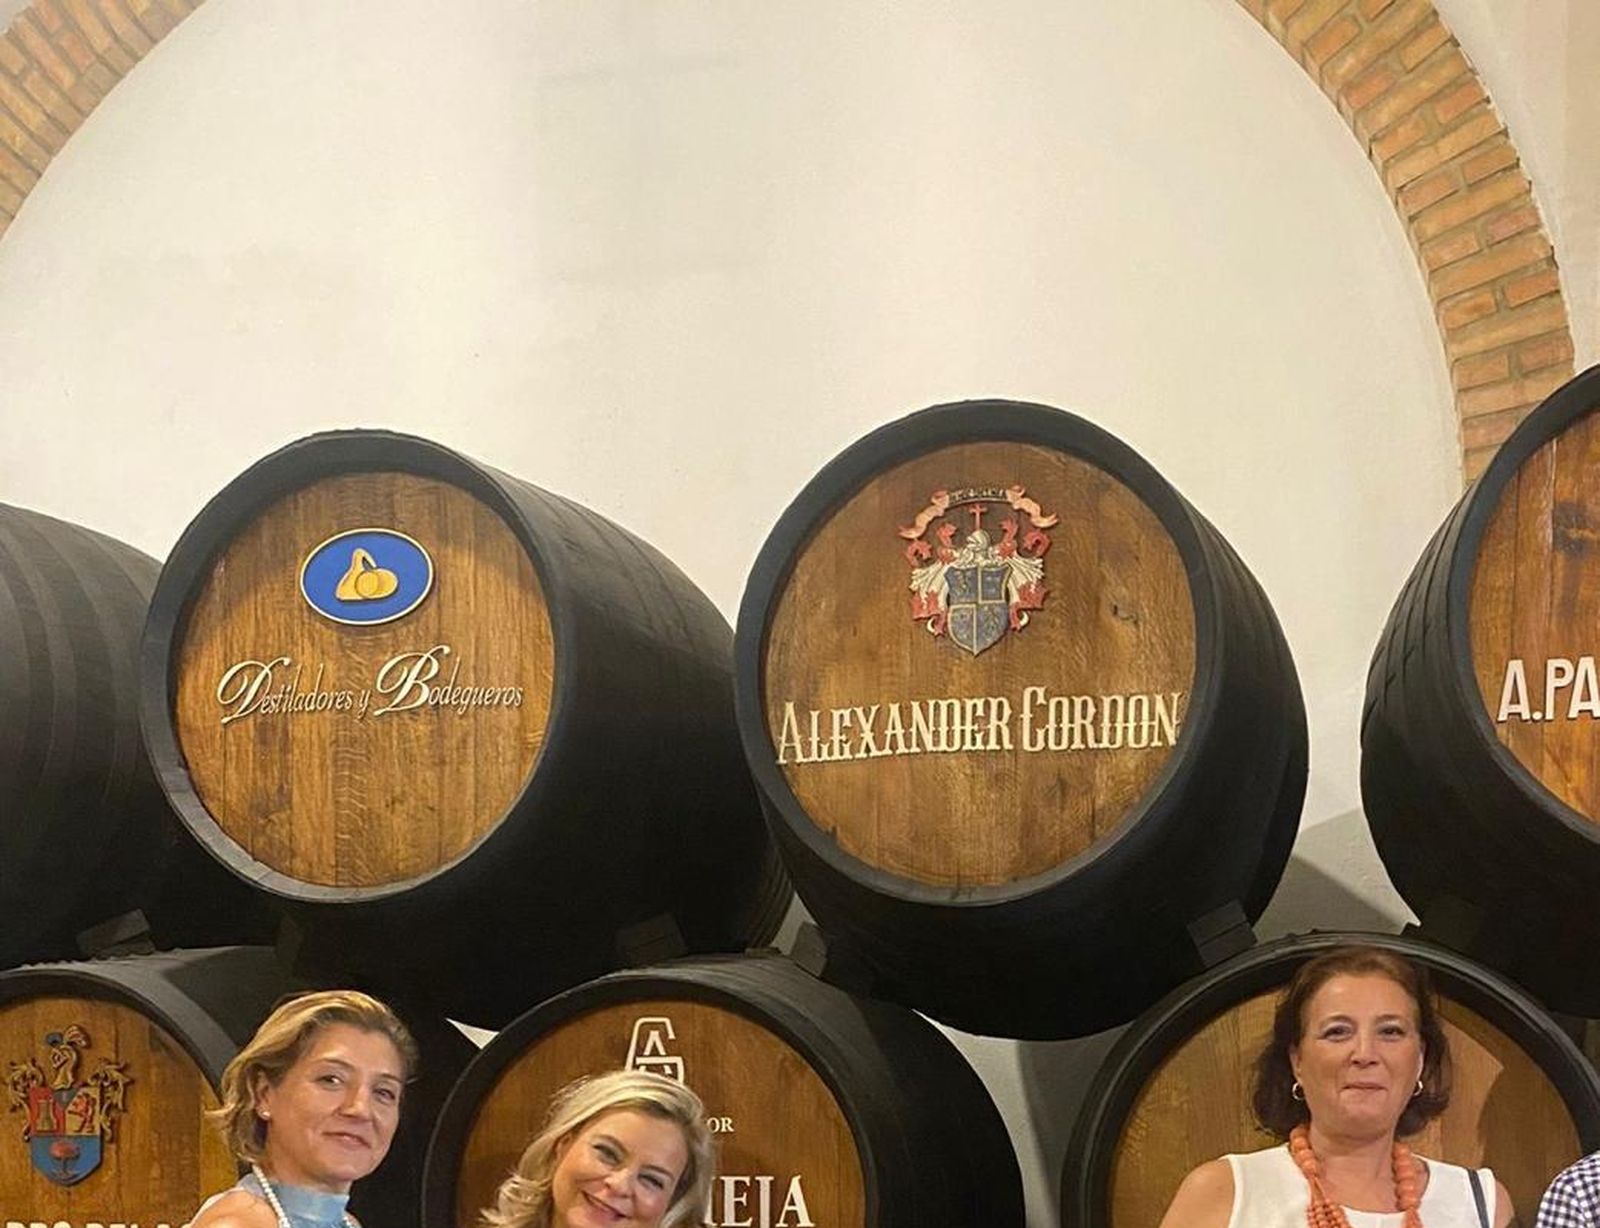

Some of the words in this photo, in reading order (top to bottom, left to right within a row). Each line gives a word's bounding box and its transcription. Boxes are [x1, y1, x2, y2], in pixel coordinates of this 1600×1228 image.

[216, 656, 353, 724] Destiladores
[358, 688, 371, 719] y
[373, 645, 523, 716] Bodegueros
[776, 699, 1014, 765] ALEXANDER
[1020, 686, 1183, 752] CORDON
